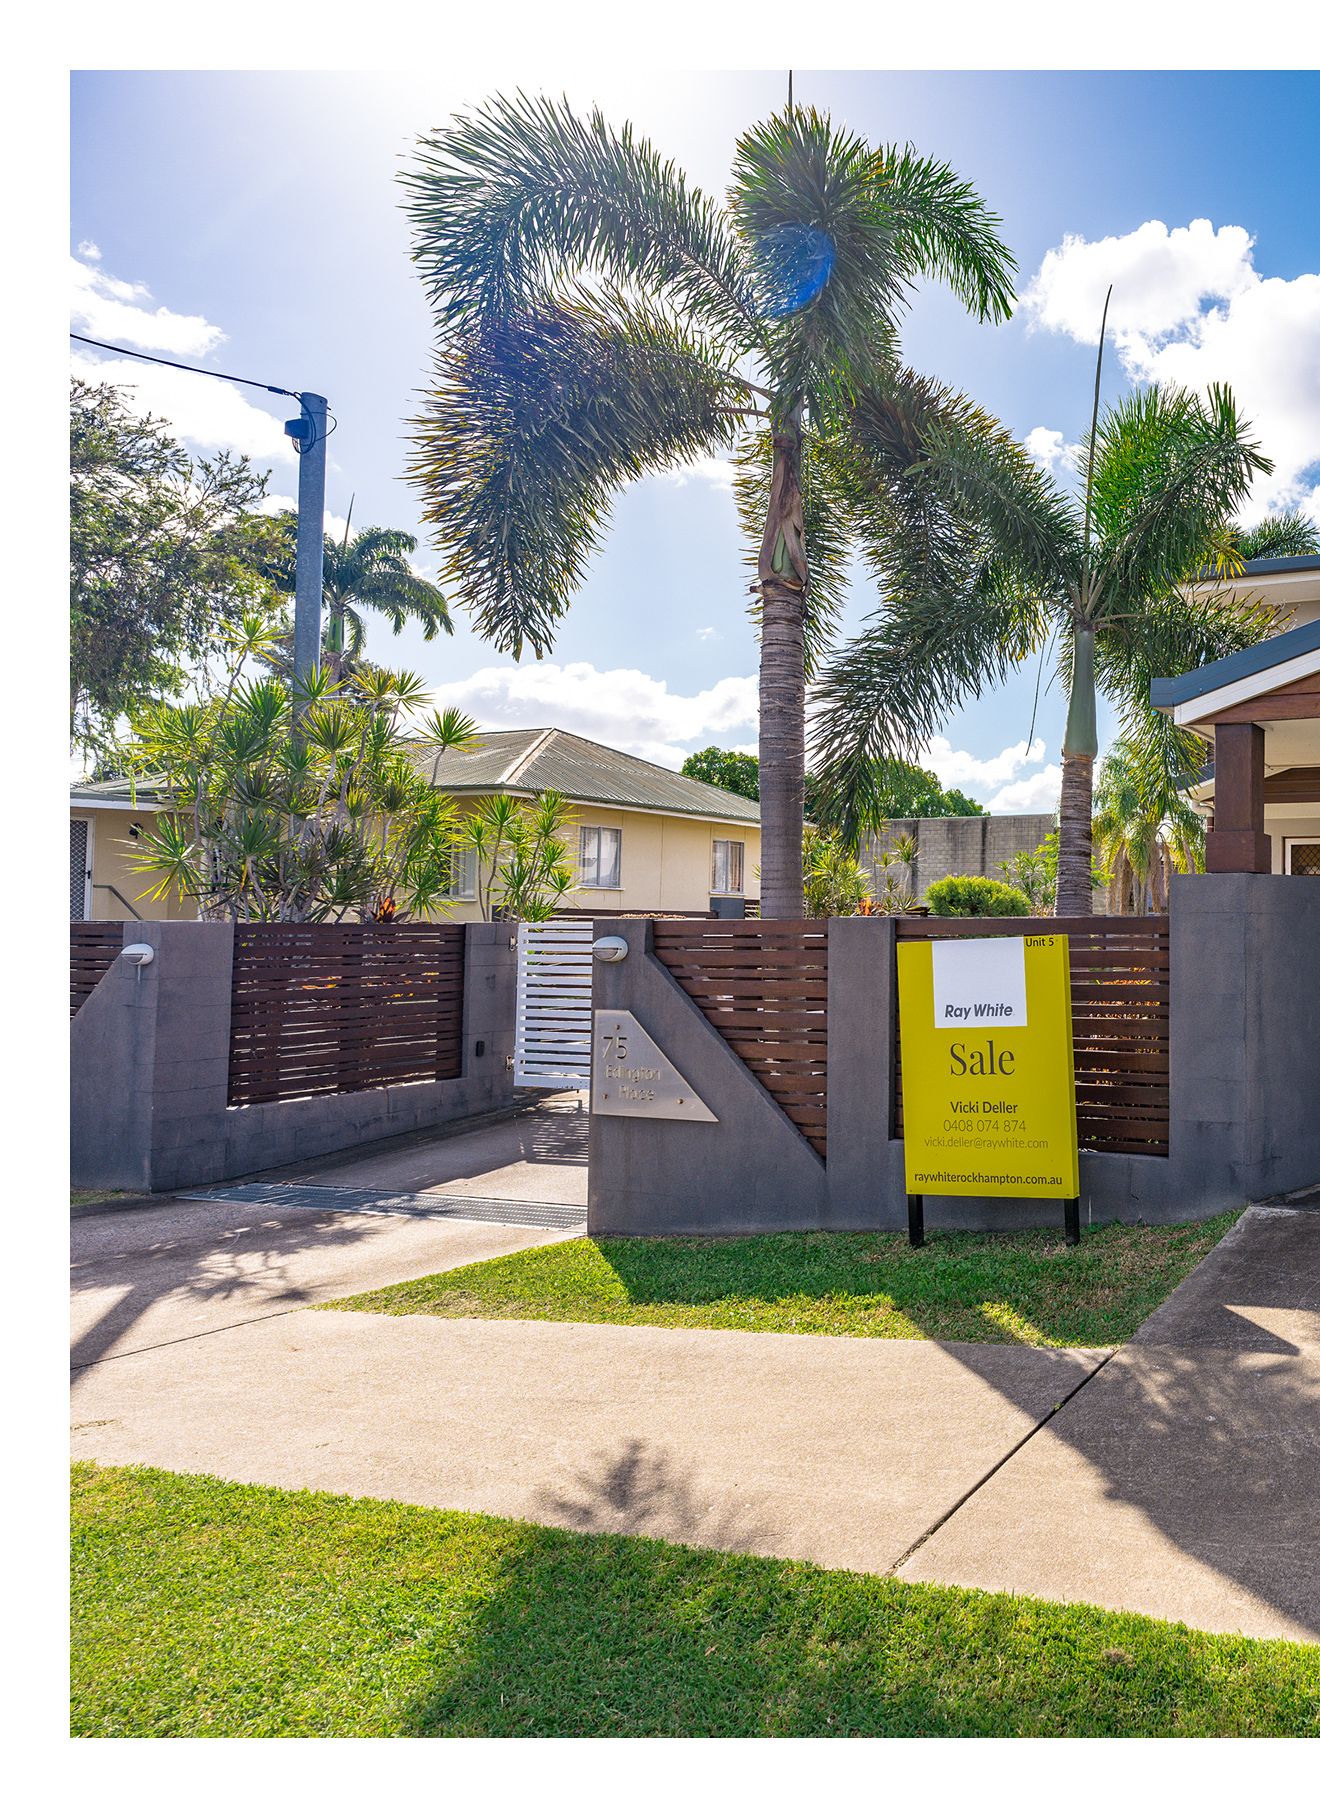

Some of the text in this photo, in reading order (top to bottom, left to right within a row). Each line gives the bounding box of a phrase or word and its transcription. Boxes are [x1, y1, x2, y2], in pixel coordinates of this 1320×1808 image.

[1025, 938, 1054, 947] Unit 5
[945, 1003, 1013, 1020] Ray White
[602, 1036, 627, 1059] 75
[950, 1040, 1015, 1076] Sale
[950, 1101, 1018, 1114] Vicki Deller
[943, 1120, 1026, 1132] 0408 074 874
[924, 1136, 1049, 1150] vicki.deller@raywhite.com
[914, 1171, 1063, 1186] raywhiterockhampton.com.au
